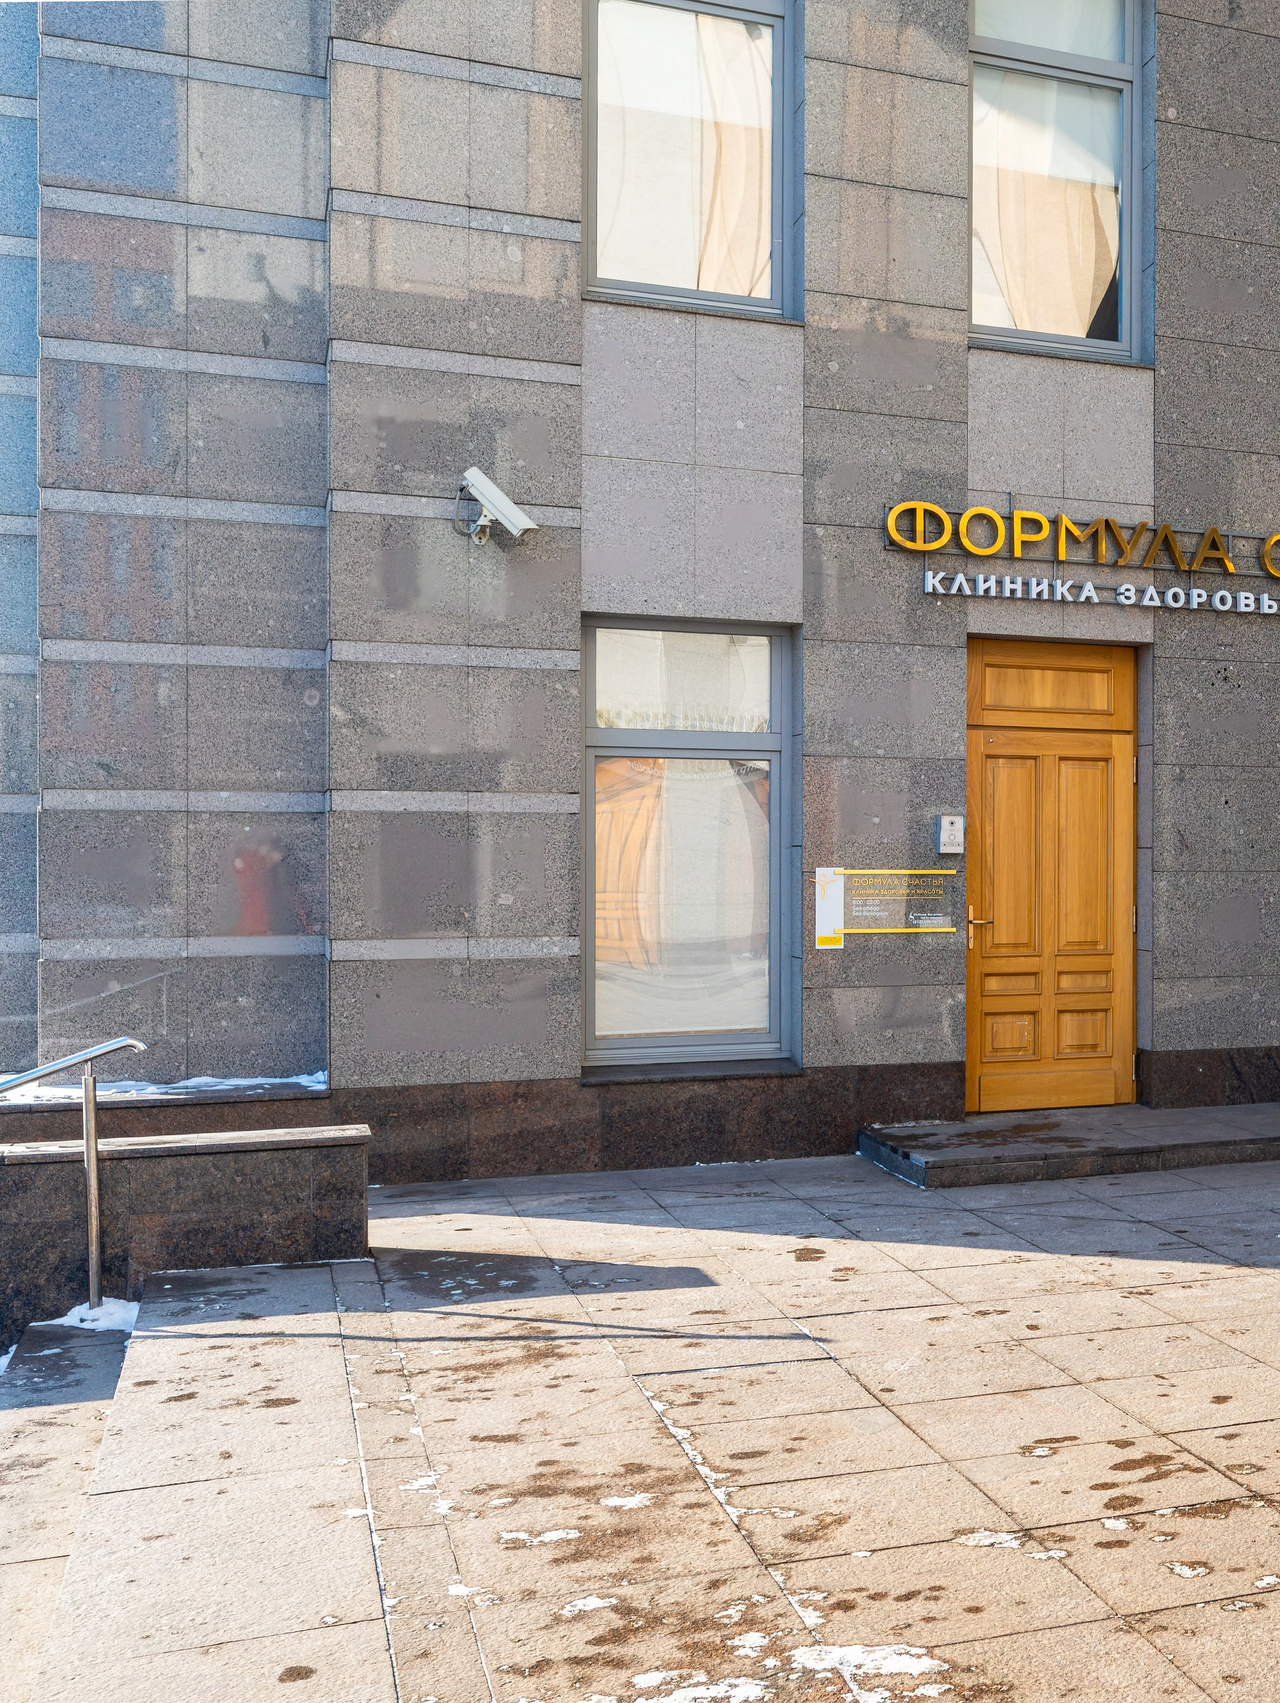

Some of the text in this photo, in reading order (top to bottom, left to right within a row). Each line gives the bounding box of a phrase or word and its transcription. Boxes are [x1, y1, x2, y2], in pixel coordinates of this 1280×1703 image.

[886, 501, 1236, 574] ФОРМУЛА
[925, 570, 1099, 603] КЛИНИКА
[852, 877, 944, 886] ФОРМУЛА СЧАСТЬЯ
